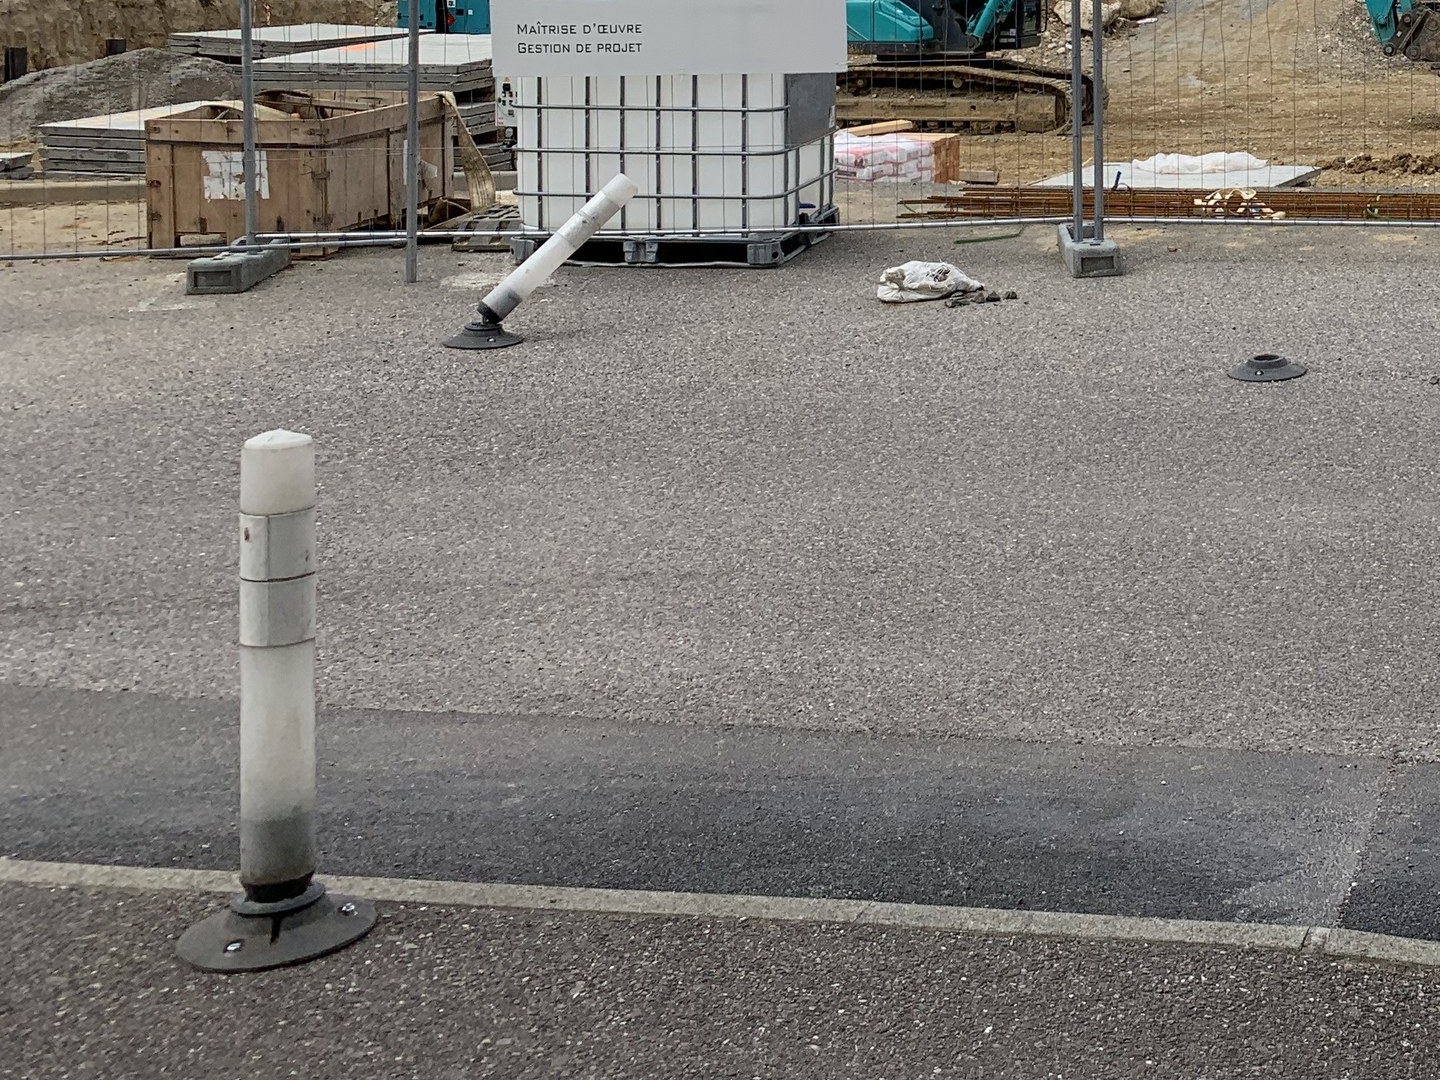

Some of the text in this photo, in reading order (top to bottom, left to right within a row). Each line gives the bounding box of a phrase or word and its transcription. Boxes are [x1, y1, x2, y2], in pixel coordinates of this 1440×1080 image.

[516, 21, 577, 35] MAÎTRISE
[517, 42, 642, 54] GESTION DE PROJET
